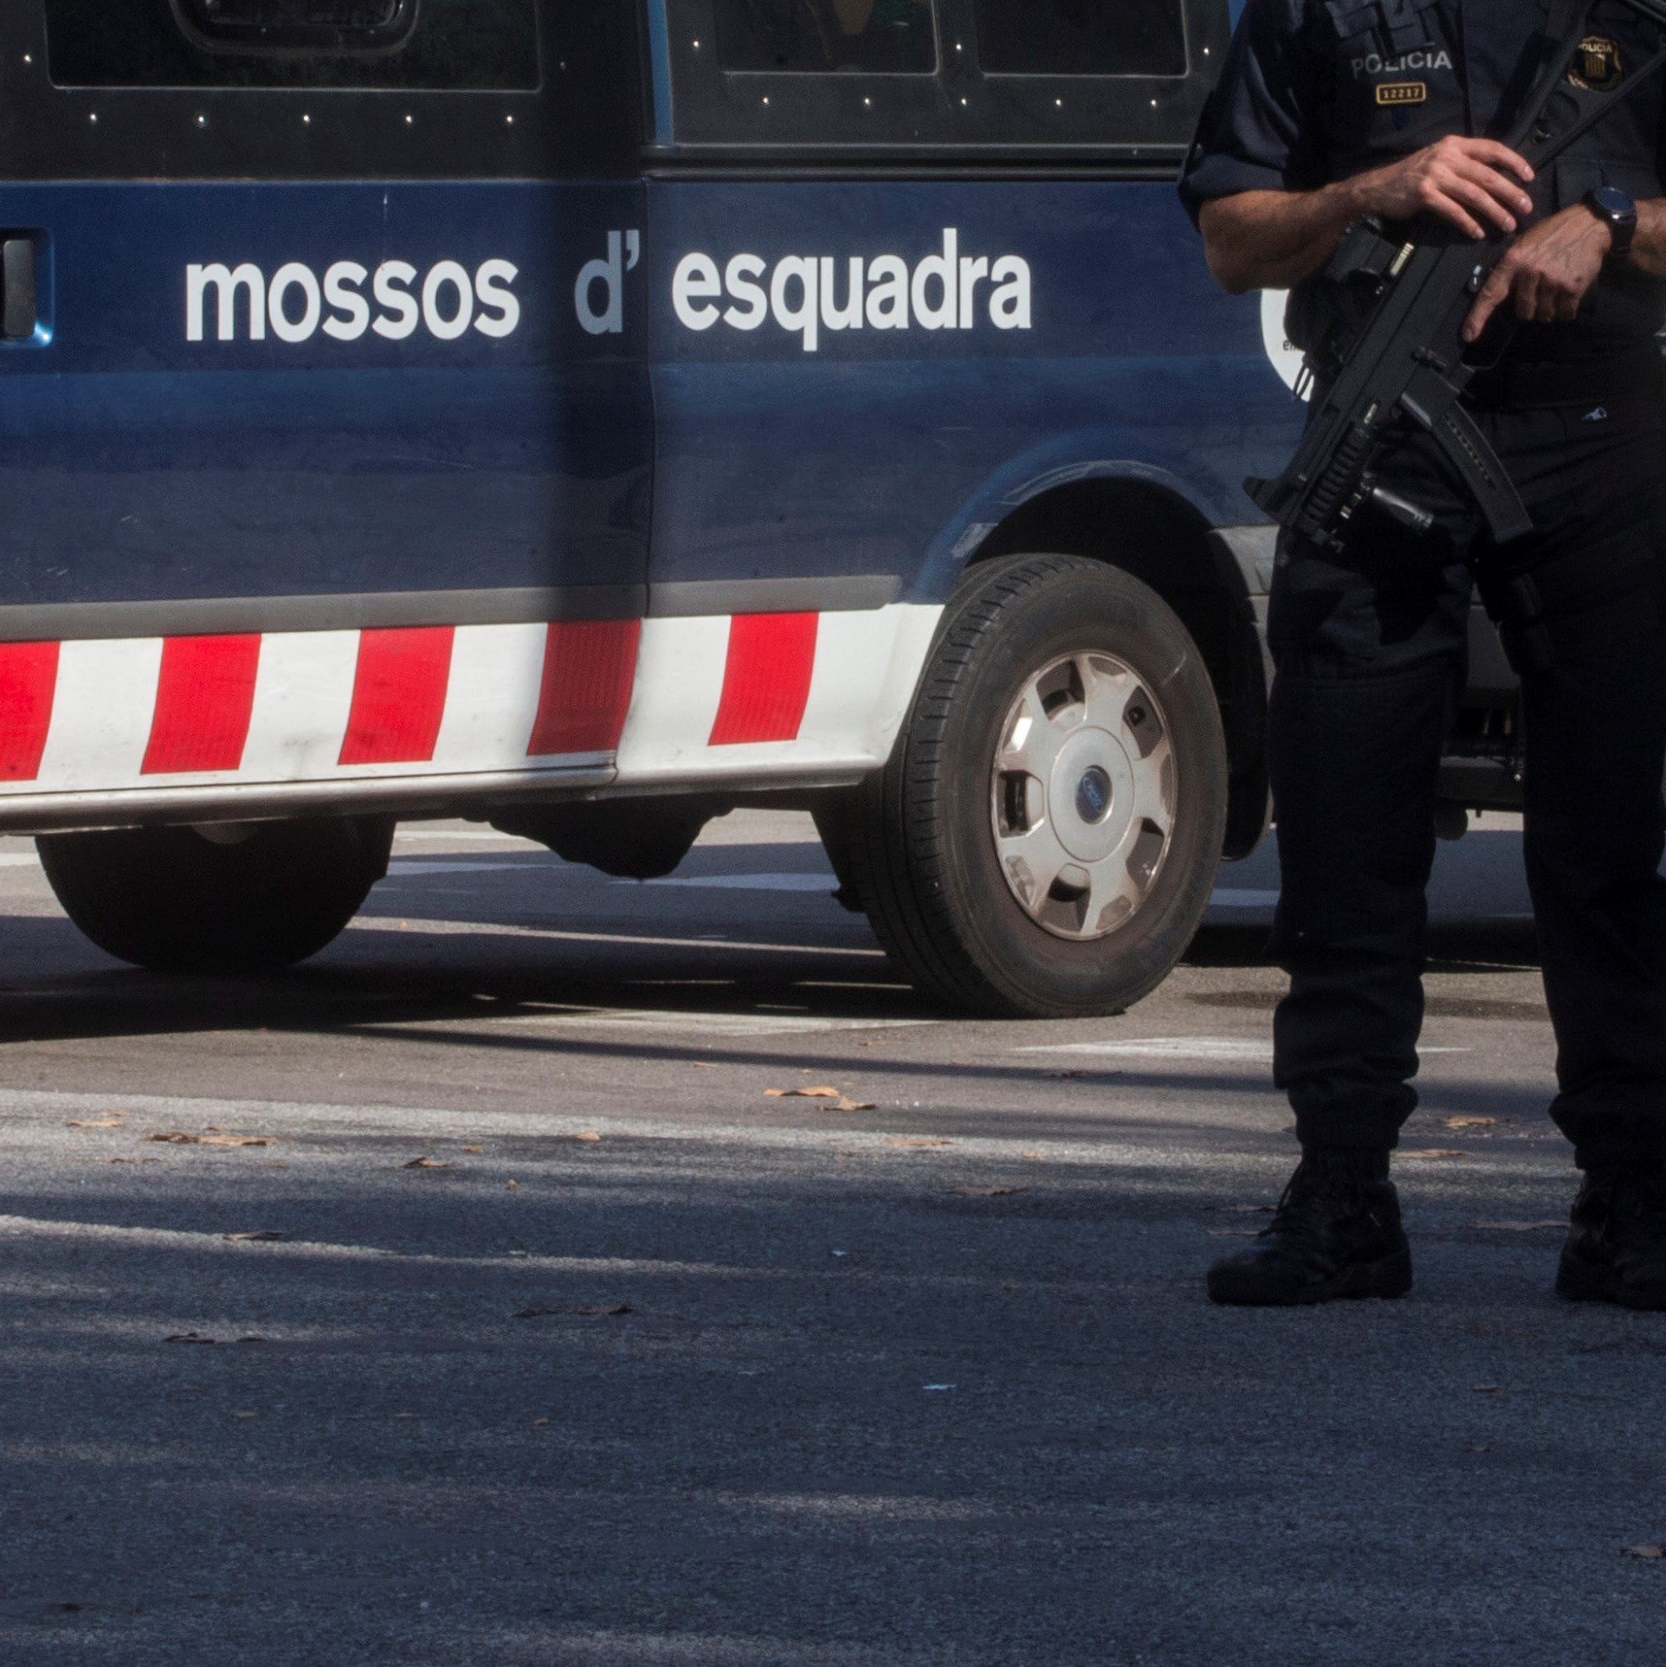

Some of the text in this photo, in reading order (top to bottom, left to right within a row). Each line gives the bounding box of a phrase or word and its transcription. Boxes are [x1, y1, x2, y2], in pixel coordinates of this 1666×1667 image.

[1351, 50, 1453, 79] POLICIA
[1382, 88, 1420, 100] 12217
[186, 258, 521, 342] mossos
[672, 228, 1032, 351] esquadra
